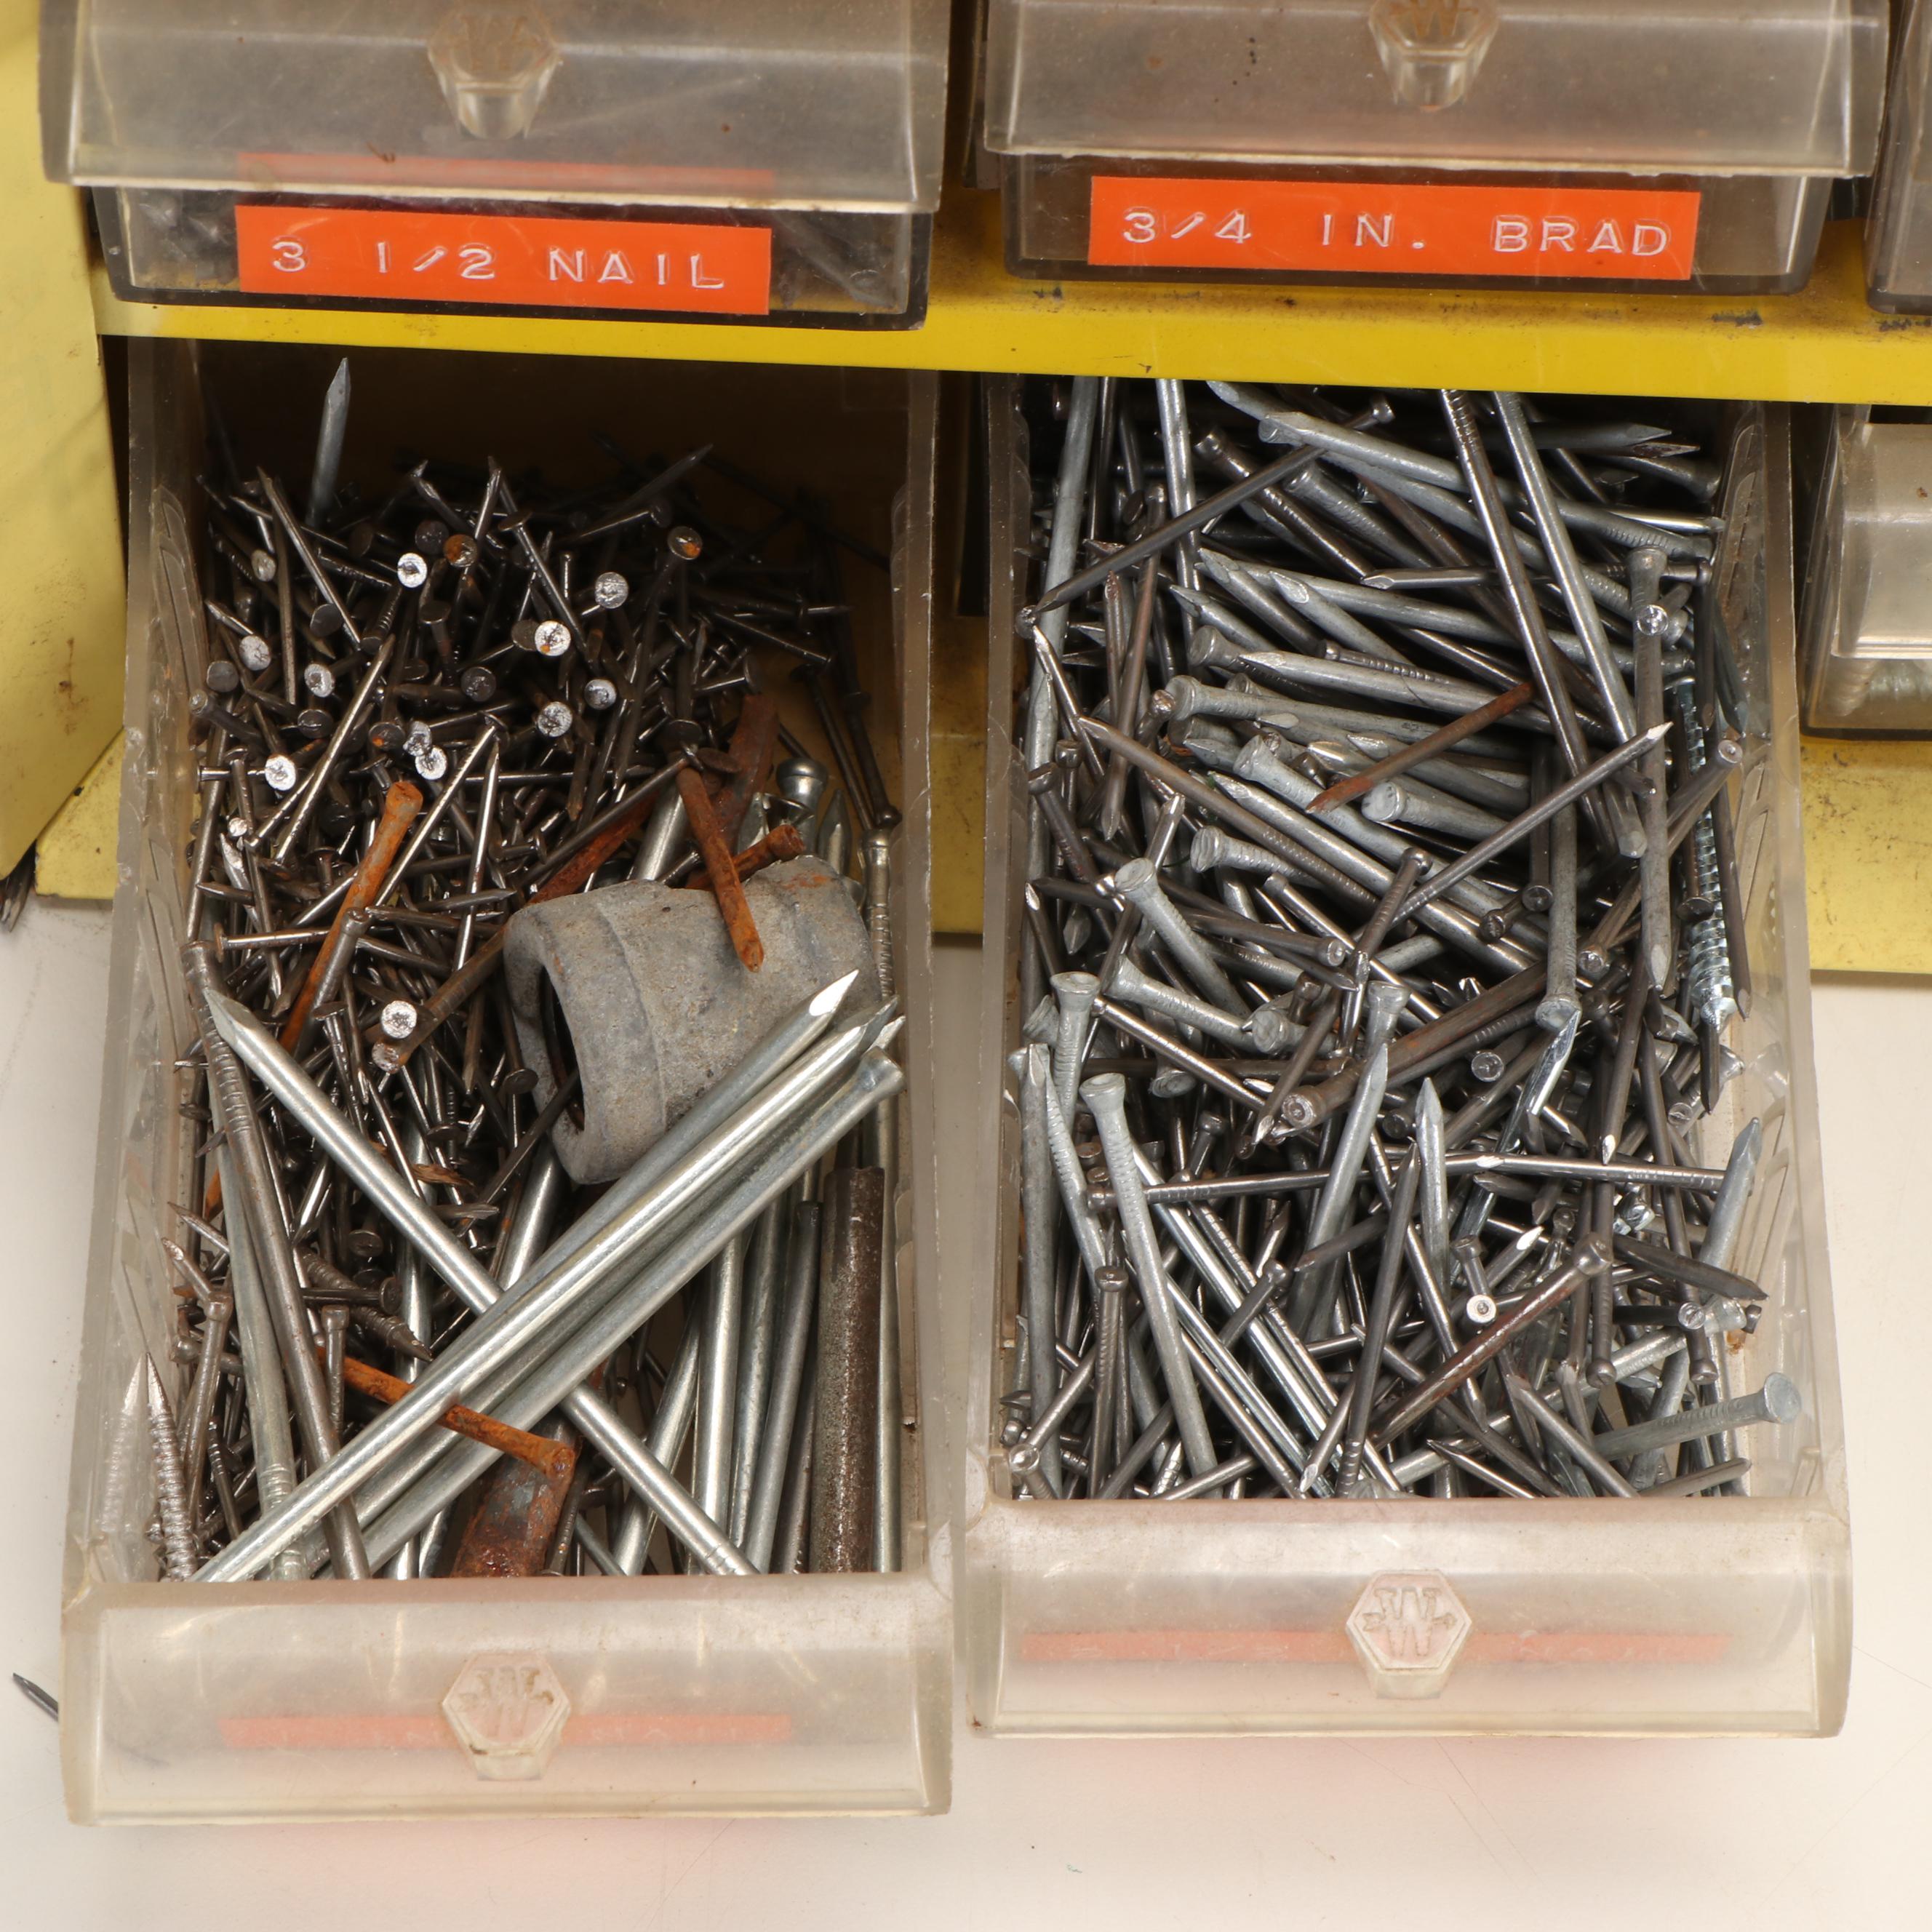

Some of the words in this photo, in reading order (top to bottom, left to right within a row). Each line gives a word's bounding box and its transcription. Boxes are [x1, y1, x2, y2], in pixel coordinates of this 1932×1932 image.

[1122, 210, 1251, 244] 3/4
[1322, 213, 1426, 250] IN.
[1493, 219, 1670, 256] BRAD
[271, 239, 308, 273] 3
[376, 241, 496, 280] 1/2
[548, 247, 725, 290] NAIL
